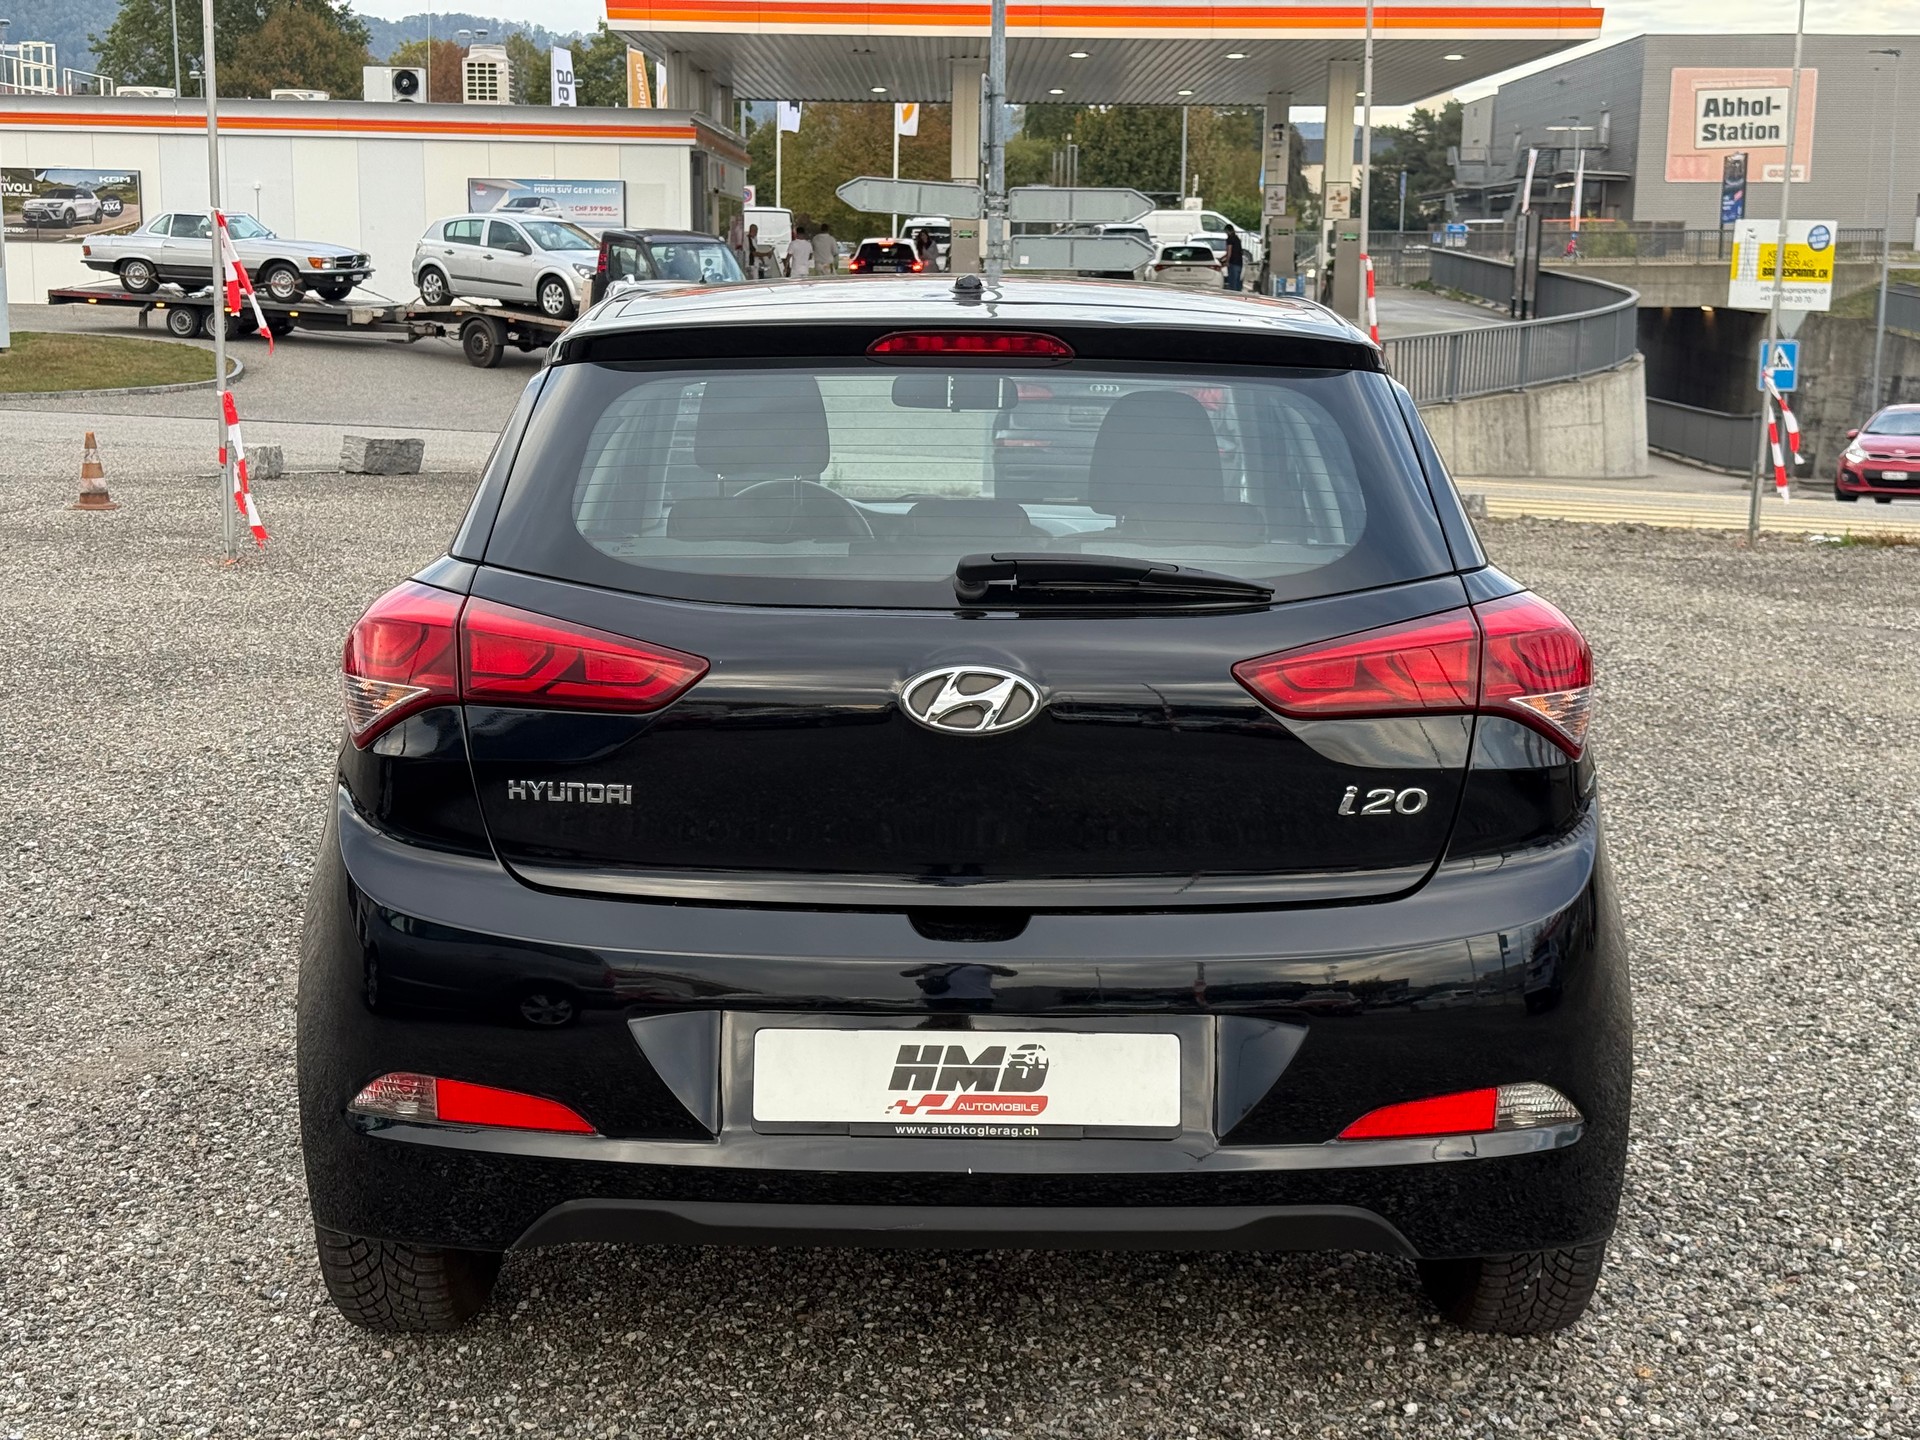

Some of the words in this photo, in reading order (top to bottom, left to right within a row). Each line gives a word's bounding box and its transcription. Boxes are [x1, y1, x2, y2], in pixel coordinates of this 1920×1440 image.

[1703, 96, 1781, 118] Abhol-
[1702, 121, 1780, 141] Station
[98, 175, 131, 184] KGM
[533, 186, 556, 194] MEHR
[557, 186, 572, 194] SUV
[508, 779, 632, 805] HYUNDAI
[1338, 785, 1429, 816] i20
[957, 1102, 1040, 1112] AUTOMOBILE
[895, 1125, 1039, 1137] www.autokoglerag.ch
